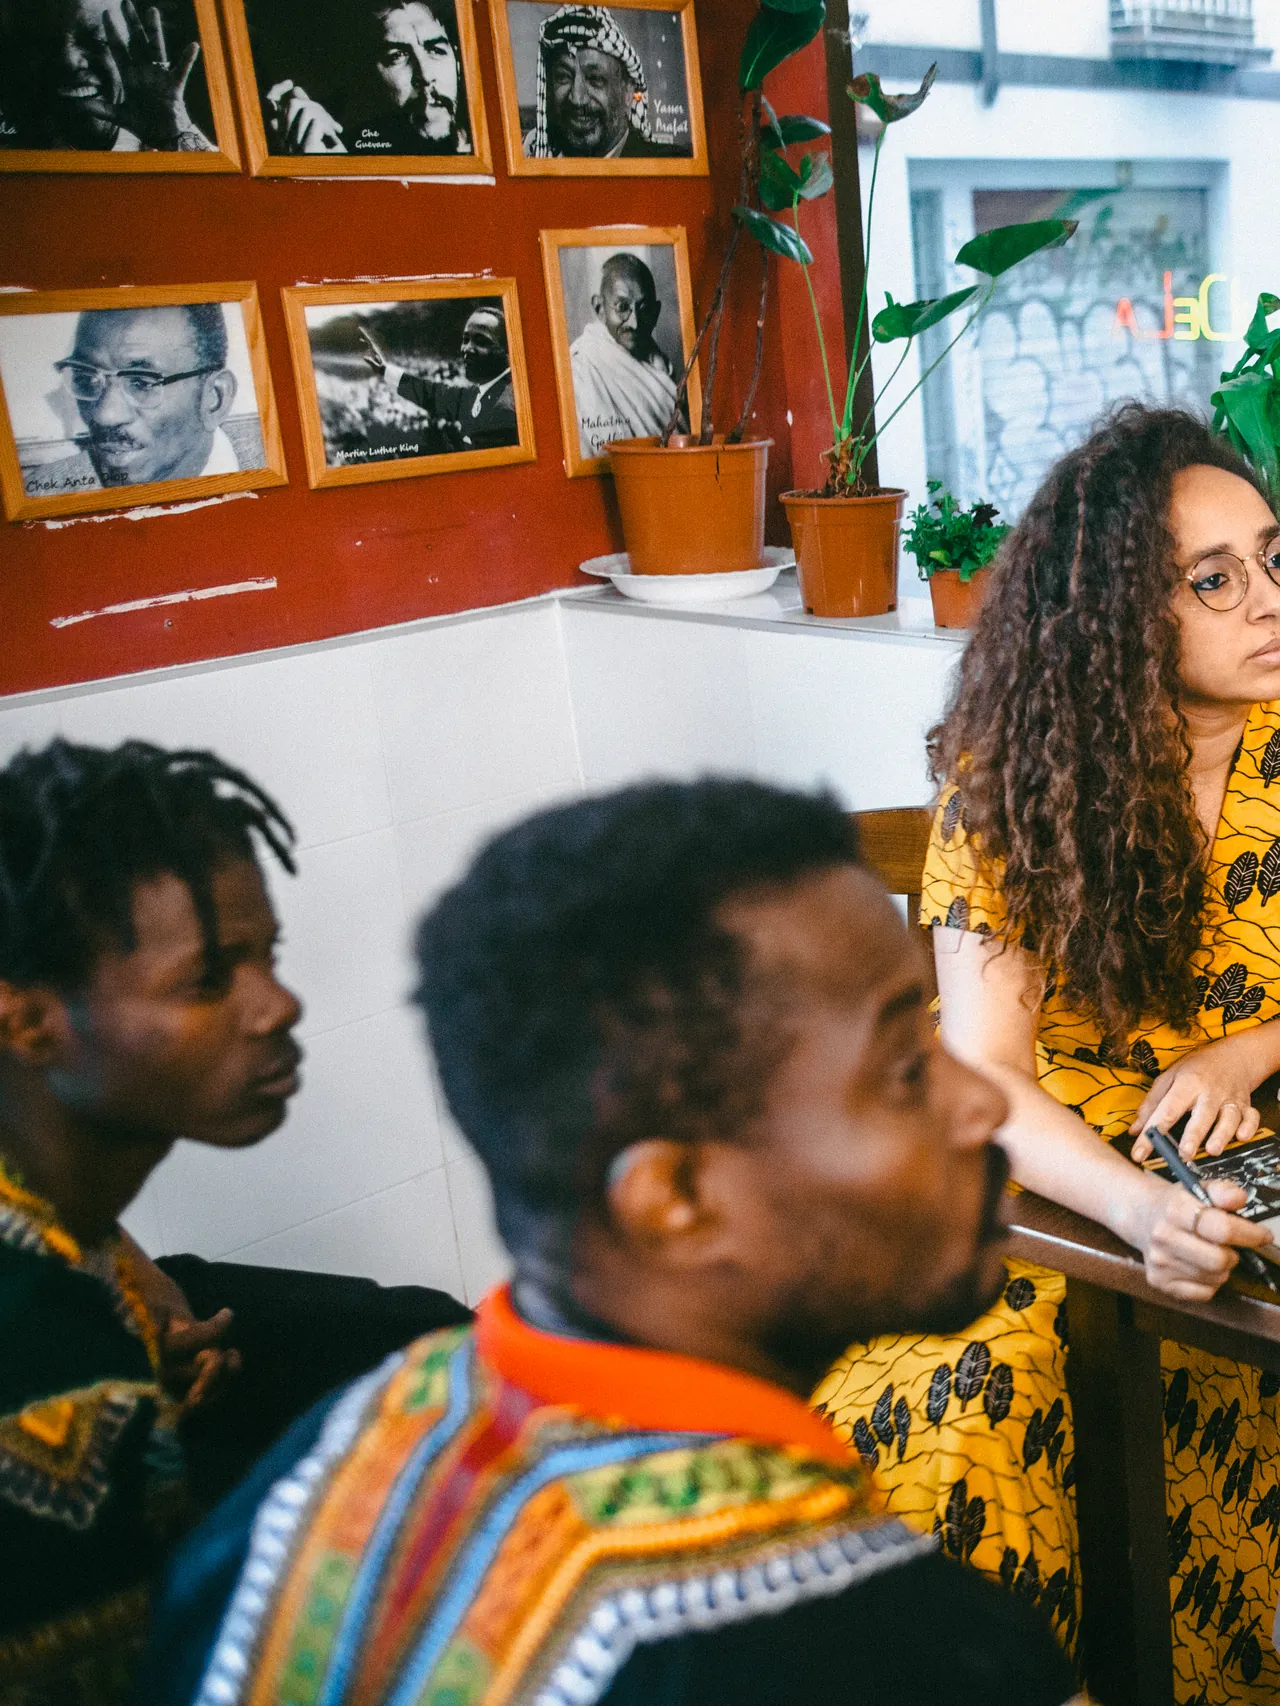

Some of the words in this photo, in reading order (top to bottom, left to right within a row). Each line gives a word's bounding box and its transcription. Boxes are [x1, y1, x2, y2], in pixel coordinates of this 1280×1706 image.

[361, 129, 380, 138] Che
[355, 140, 393, 149] Guevara
[336, 449, 368, 459] Martin
[369, 446, 398, 456] Luther
[399, 443, 419, 453] King
[25, 479, 58, 493] Chek
[62, 476, 95, 488] Anta
